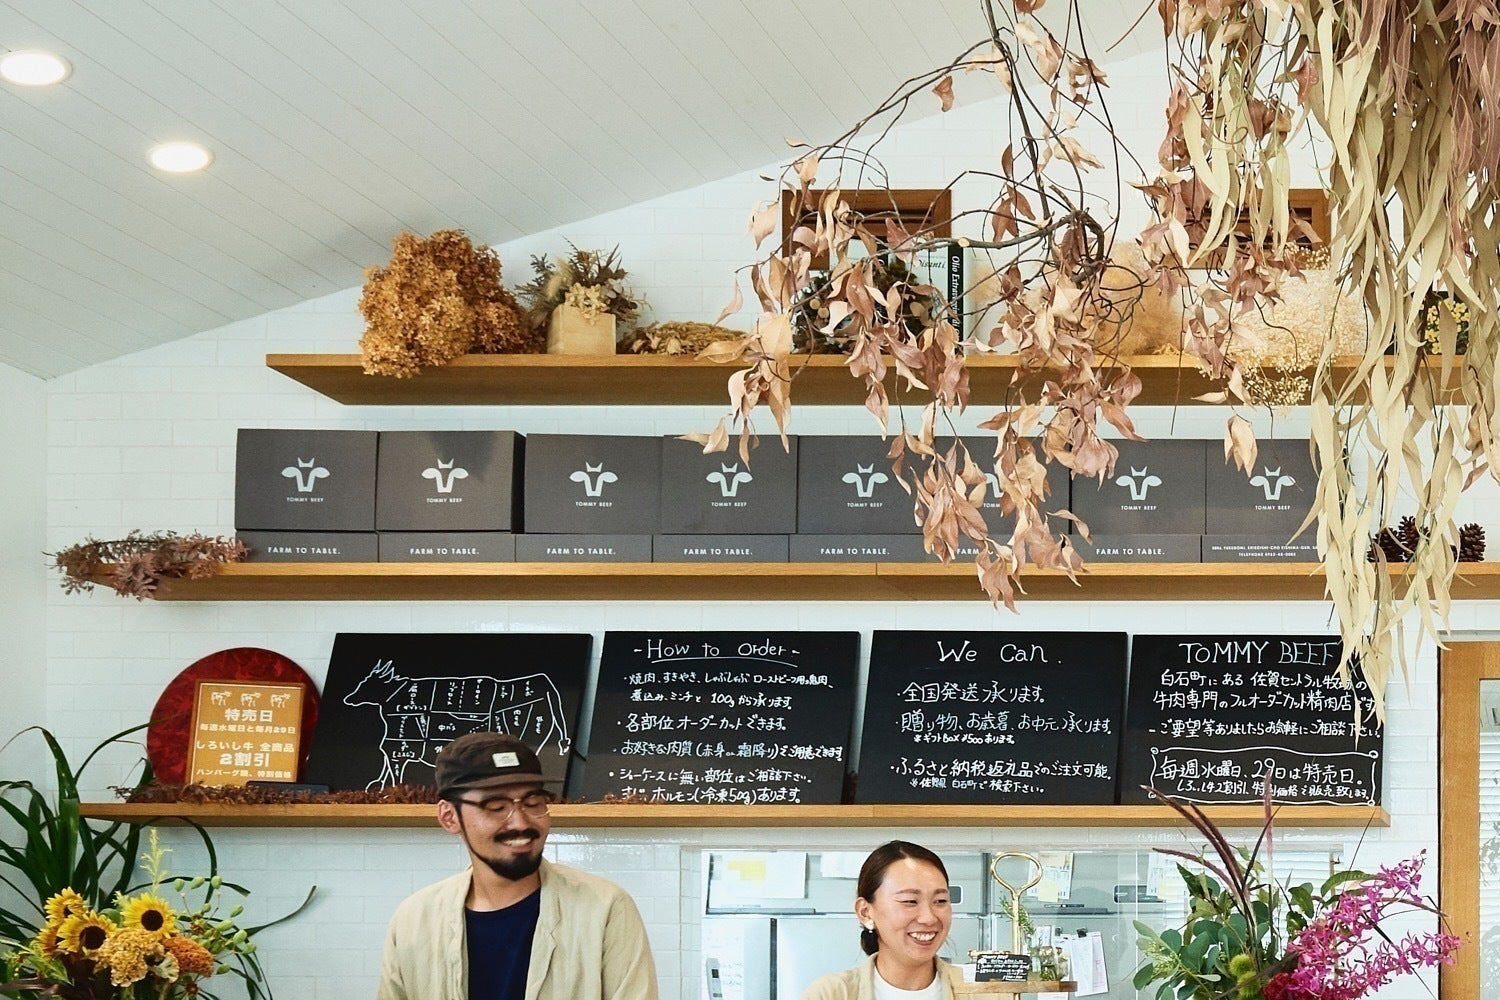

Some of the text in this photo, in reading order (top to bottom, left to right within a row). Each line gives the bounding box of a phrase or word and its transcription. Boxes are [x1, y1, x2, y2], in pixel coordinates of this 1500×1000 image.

[268, 546, 292, 554] FARM
[1096, 548, 1120, 556] FARM
[1122, 548, 1134, 556] TO
[702, 642, 720, 657] to
[937, 640, 978, 662] We
[1178, 641, 1341, 666] TOMMY BEEF
[224, 708, 273, 722] 特売日
[196, 740, 254, 750] しろいし牛
[220, 752, 270, 768] 2割引
